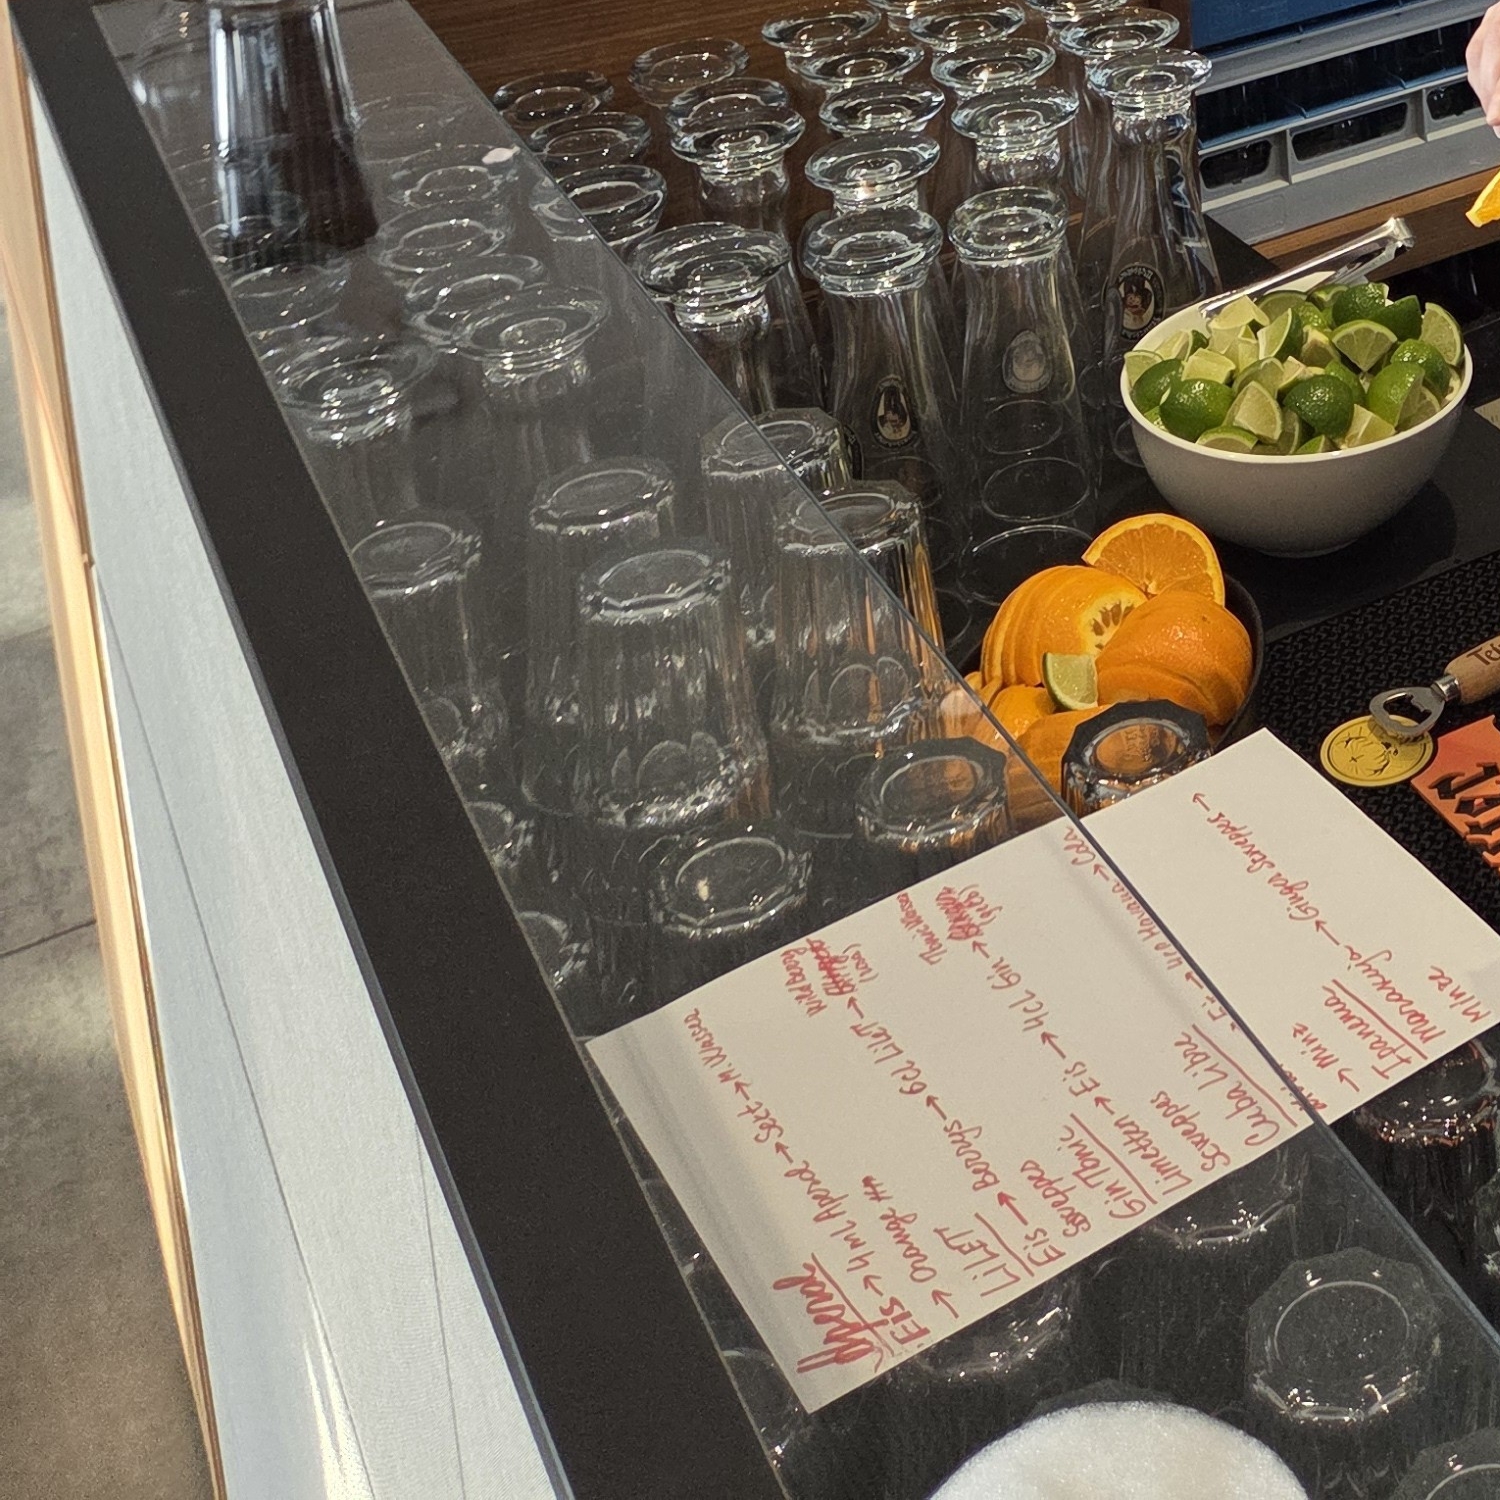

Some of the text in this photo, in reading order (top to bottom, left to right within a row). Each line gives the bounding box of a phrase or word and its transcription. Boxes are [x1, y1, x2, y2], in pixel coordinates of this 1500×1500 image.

[1063, 826, 1096, 865] Cola
[1267, 871, 1319, 920] Ginger
[987, 956, 1021, 990] Gin
[1427, 966, 1490, 1022] Minze
[1322, 986, 1411, 1079] Ipanema
[1064, 1061, 1100, 1097] Eis
[1173, 1031, 1280, 1146] Cuba Libre
[943, 1119, 1000, 1192] Berrys
[1113, 1115, 1192, 1195] Limetten
[783, 1160, 848, 1223] Aperol
[1104, 1180, 1146, 1219] Gin
[879, 1207, 937, 1283] Orange
[1023, 1227, 1065, 1267] Eis
[772, 1257, 889, 1373] Aperol
[879, 1296, 930, 1344] Eis
